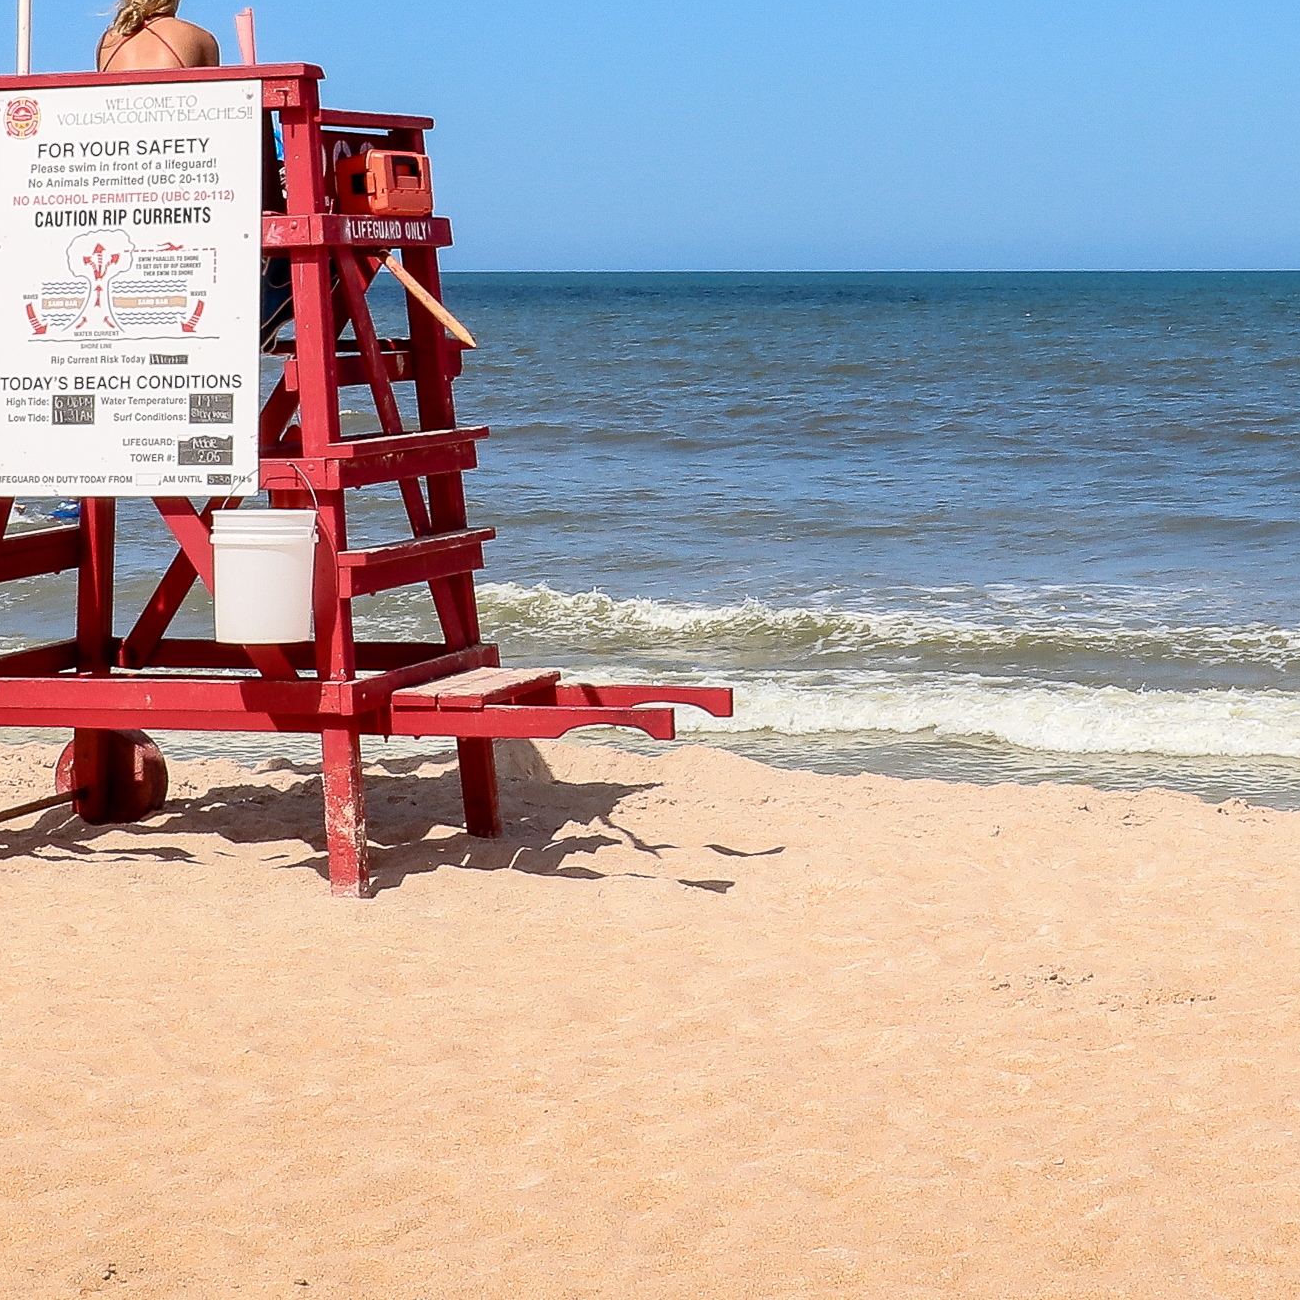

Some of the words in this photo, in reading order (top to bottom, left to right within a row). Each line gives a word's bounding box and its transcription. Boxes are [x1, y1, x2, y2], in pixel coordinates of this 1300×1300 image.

[106, 97, 176, 111] WELCOME
[178, 95, 197, 107] TO
[57, 112, 116, 126] VOLUSIA
[117, 110, 178, 123] COUNTY
[38, 143, 74, 158] FOR
[80, 141, 129, 157] YOUR
[137, 138, 210, 155] SAFETY
[31, 163, 65, 174] Please
[69, 162, 96, 172] swim
[99, 161, 109, 171] in
[113, 160, 138, 171] front
[141, 160, 153, 170] of
[155, 161, 162, 169] a
[165, 158, 217, 171] lifeguard!
[28, 178, 43, 188] No
[46, 176, 89, 187] Animals
[92, 174, 144, 186] Permitted
[147, 173, 176, 185] (UBC
[179, 172, 219, 184] 20-113)
[13, 195, 30, 206] NO
[33, 194, 89, 205] ALCOHOL
[92, 192, 158, 204] PERMITTED
[161, 191, 191, 203] (UBC
[194, 190, 235, 202] 20-112)
[35, 211, 97, 227] CAUTION
[103, 209, 127, 225] RIP
[133, 207, 211, 225] CURRENTS
[351, 220, 401, 239] LIFEGUARD
[405, 221, 427, 240] ONLY
[51, 356, 64, 365] Rip
[68, 356, 98, 364] Current
[101, 355, 118, 363] Risk
[121, 355, 145, 365] Today
[0, 377, 69, 391] TODAY'S
[74, 376, 130, 389] BEACH
[136, 374, 243, 389] CONDITIONS
[6, 398, 27, 407] High
[28, 397, 49, 406] Tide:
[101, 397, 128, 406] Water
[129, 396, 187, 407] Temperature:
[8, 414, 27, 422] Low
[28, 414, 49, 422] Tide:
[113, 413, 135, 421] Surf
[136, 412, 187, 422] Conditions:
[123, 438, 176, 448] LIFEGUARD:
[130, 453, 164, 463] TOWER
[42, 475, 55, 484] ON
[56, 475, 78, 484] DUTY
[80, 475, 106, 484] TODAY
[108, 475, 133, 484] FROM
[162, 475, 177, 484] AM
[178, 475, 203, 483] UNTIL
[233, 475, 246, 483] PM
